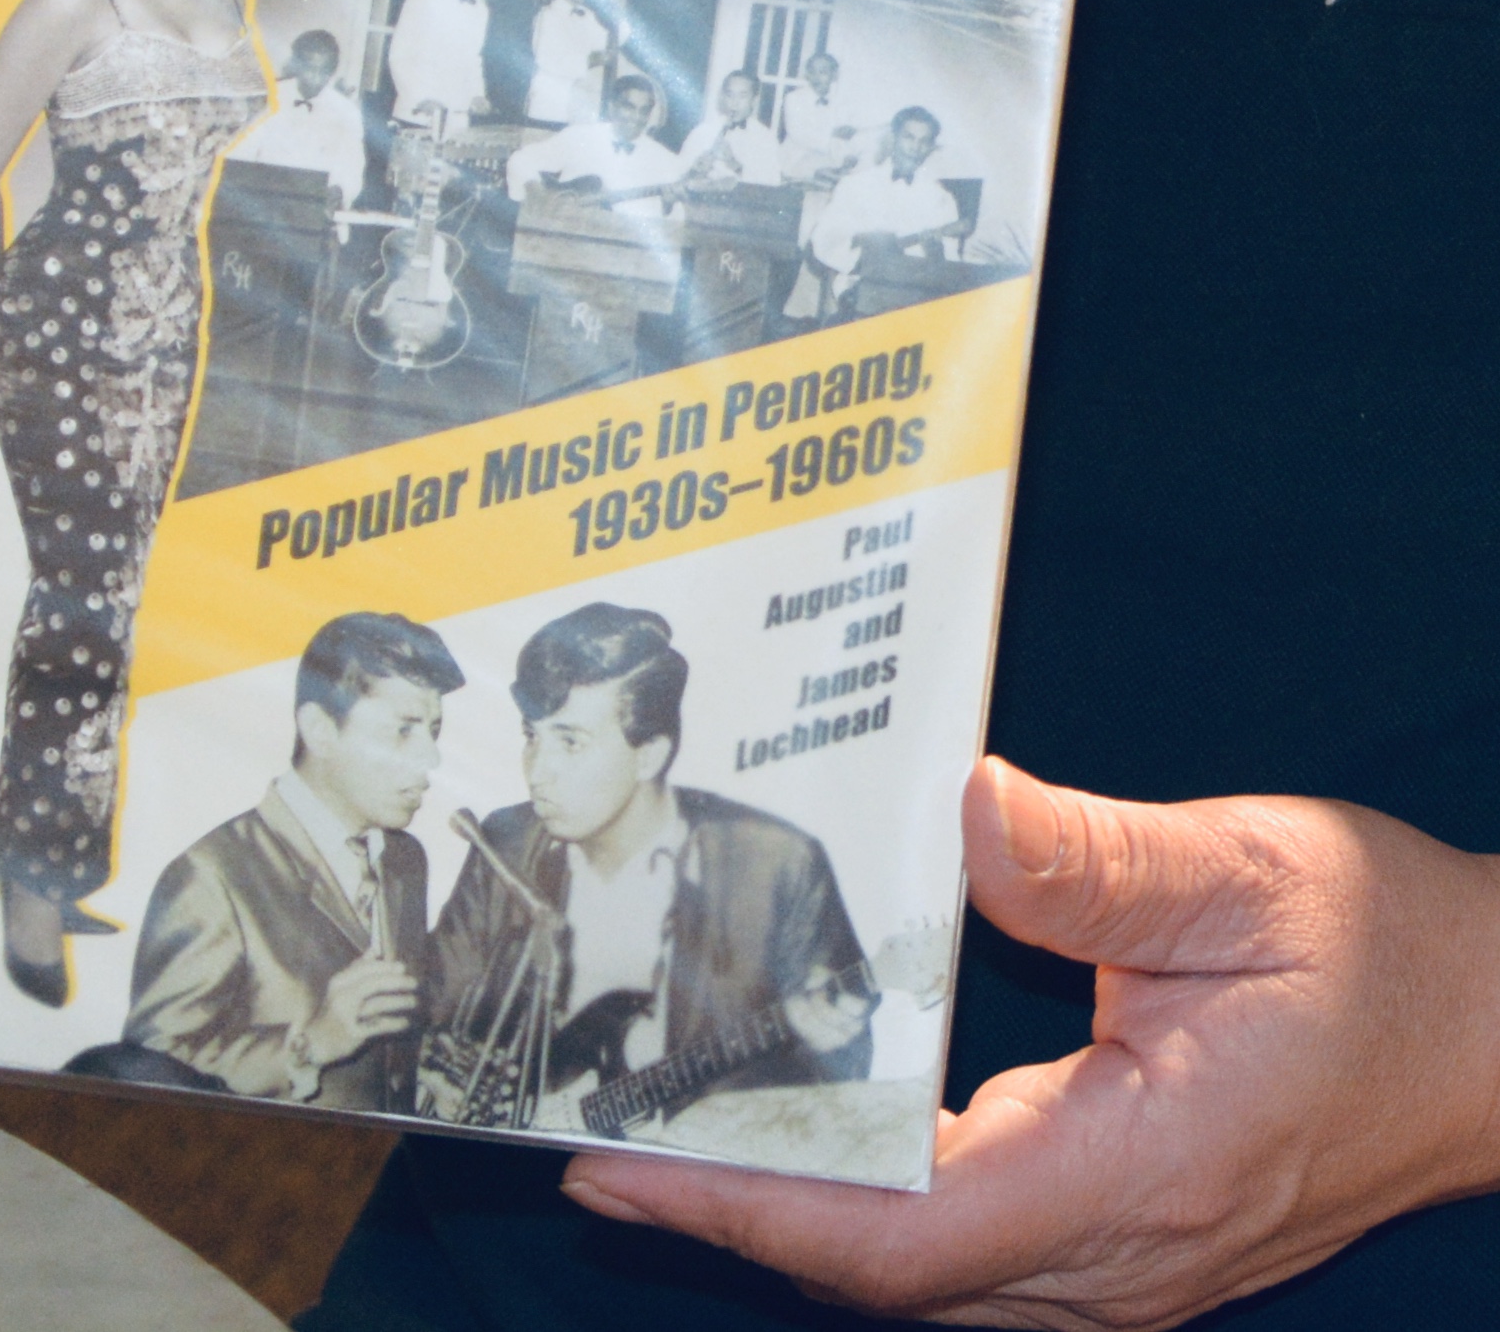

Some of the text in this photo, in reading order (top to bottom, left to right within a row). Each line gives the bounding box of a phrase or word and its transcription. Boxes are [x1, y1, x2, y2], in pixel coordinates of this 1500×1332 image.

[256, 342, 933, 570] Popular Music in Penang,
[844, 512, 913, 561] Paul
[764, 561, 908, 630] Augustin
[842, 601, 905, 652] and
[799, 652, 898, 709] James
[736, 696, 892, 773] Lochhead
